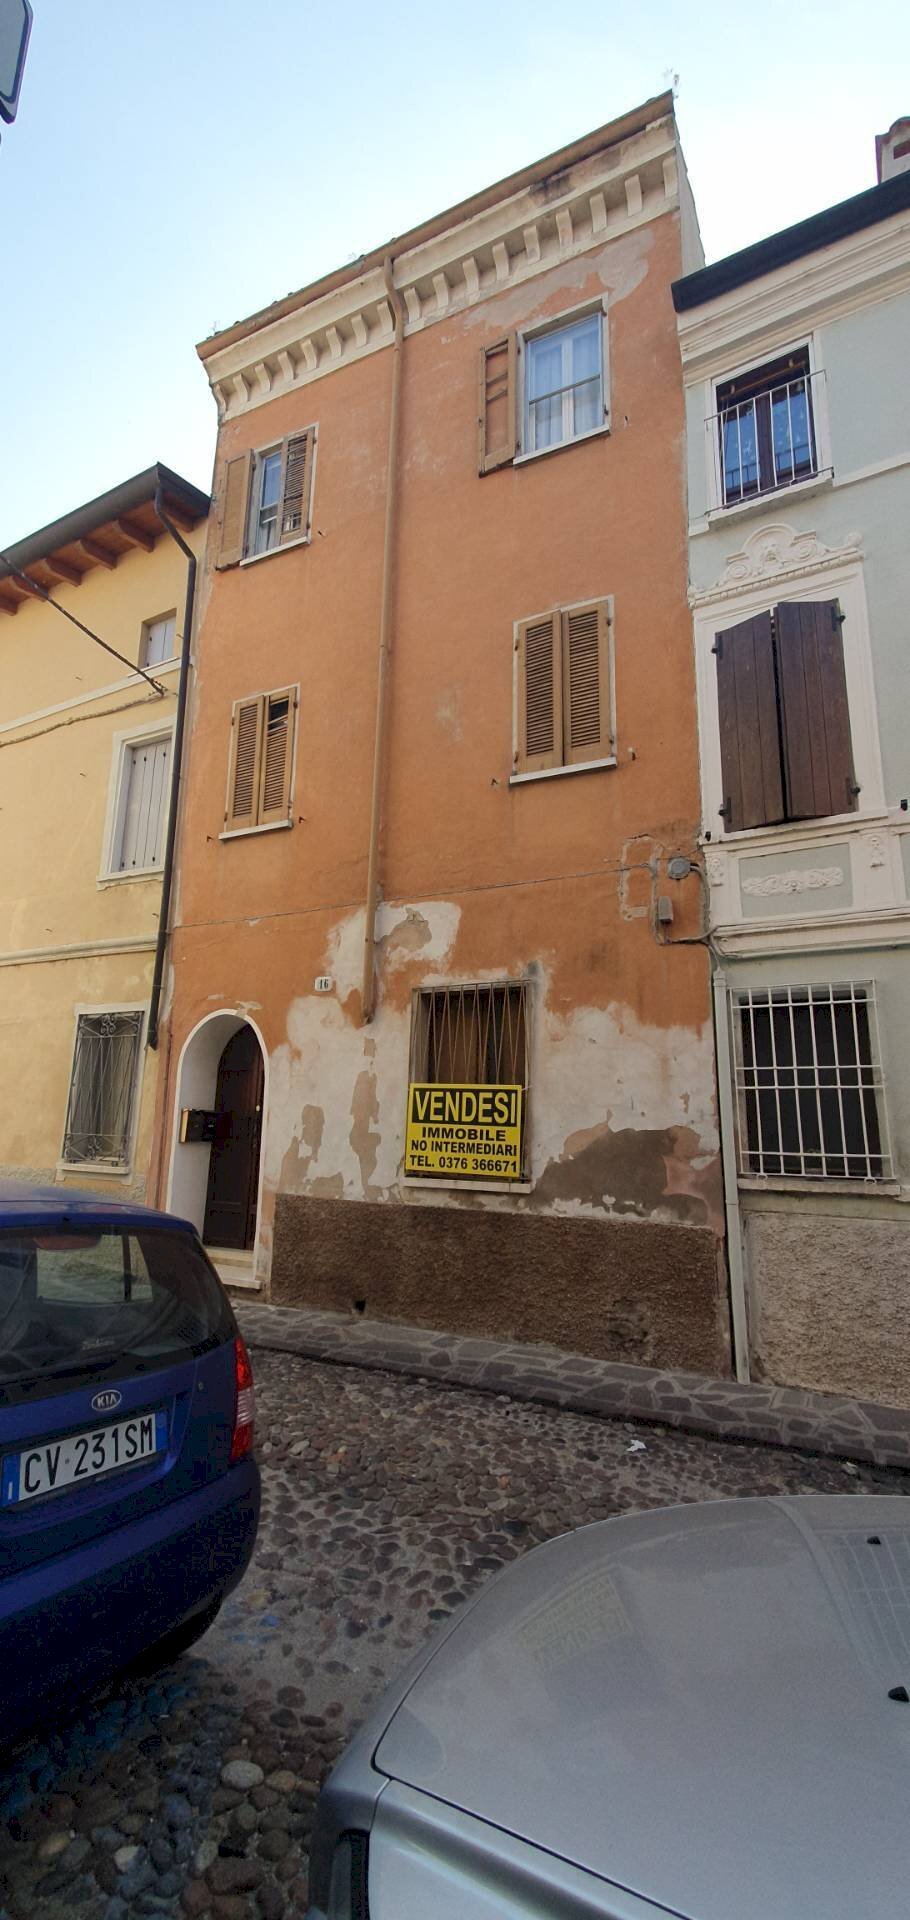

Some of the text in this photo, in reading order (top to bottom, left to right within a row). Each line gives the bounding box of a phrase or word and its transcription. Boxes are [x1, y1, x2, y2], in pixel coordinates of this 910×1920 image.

[318, 979, 329, 990] 16
[415, 1091, 516, 1124] VENDESI
[422, 1127, 506, 1142] IMMOBILE
[411, 1140, 517, 1156] NO INTERMEDIARI
[410, 1154, 517, 1173] TEL. 0376 366671
[97, 1393, 117, 1408] KIA
